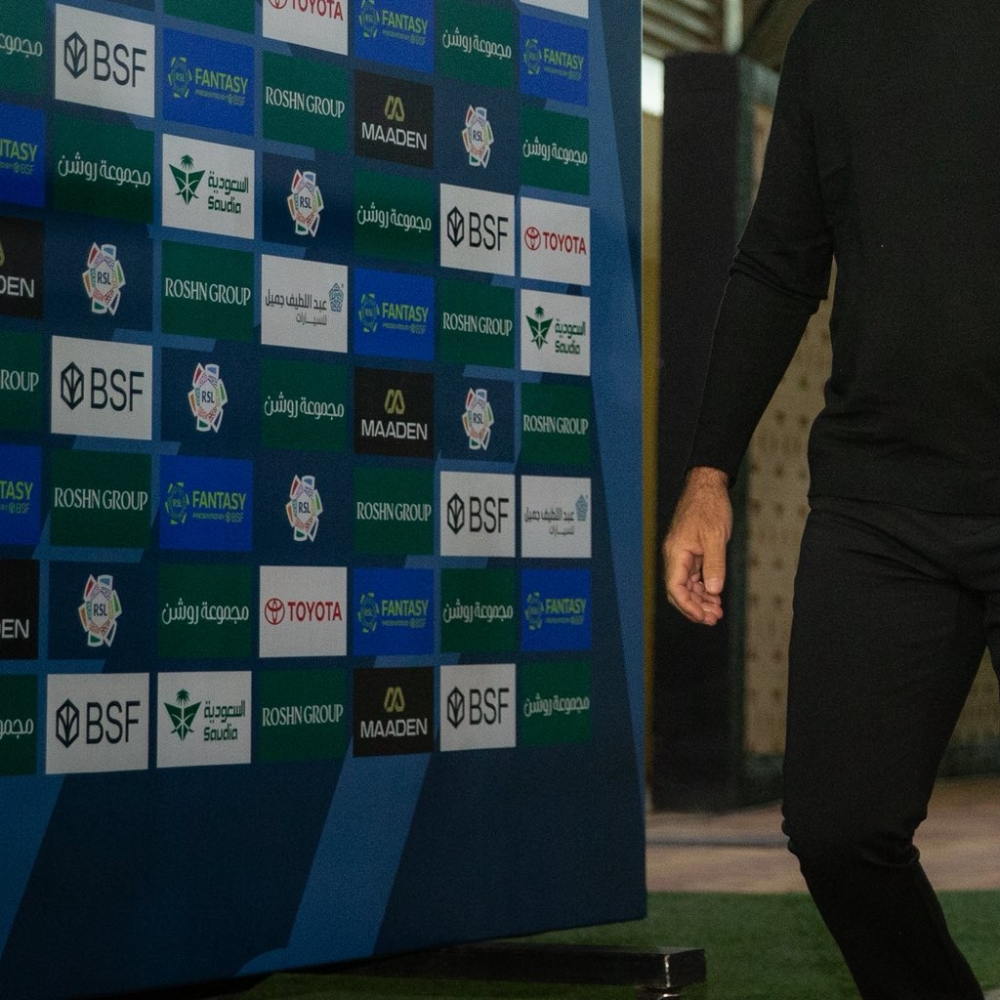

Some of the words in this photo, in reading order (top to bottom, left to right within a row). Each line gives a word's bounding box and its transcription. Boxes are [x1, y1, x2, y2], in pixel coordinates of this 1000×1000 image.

[382, 9, 428, 34] FANTASY
[442, 27, 472, 53] روشن
[473, 35, 511, 59] مجموعة
[94, 39, 146, 87] BSF
[195, 68, 248, 93] FANTASY
[265, 86, 304, 110] ROSHN
[306, 95, 345, 118] GROUP
[362, 122, 427, 149] MAADEN
[473, 130, 483, 142] RSL
[0, 138, 38, 162] TASY
[58, 152, 97, 181] روشن
[99, 160, 151, 187] مجموعة
[208, 172, 249, 197] السعودية
[208, 195, 241, 214] Saudia
[300, 196, 312, 209] RSL
[357, 202, 389, 228] روشن
[390, 208, 431, 232] مجموعة
[469, 211, 508, 250] BSF
[543, 232, 586, 255] TOYOTA
[97, 271, 111, 285] RSL
[165, 277, 207, 300] ROSHN
[209, 283, 251, 305] GROUP
[382, 302, 428, 322] FANTASY
[443, 311, 477, 331] ROSHN
[479, 317, 512, 336] GROUP
[91, 367, 144, 411] BSF
[201, 390, 214, 403] RSL
[264, 392, 298, 418] روشن
[299, 397, 344, 420] مجموعة
[362, 419, 427, 439] MAADEN
[473, 412, 483, 424] RSL
[523, 414, 555, 432] ROSHN
[556, 417, 588, 435] GROUP
[54, 487, 100, 508] ROSHN
[102, 490, 148, 511] GROUP
[192, 490, 246, 510] FANTASY
[298, 501, 310, 513] RSL
[356, 501, 393, 520] ROSHN
[395, 503, 431, 521] GROUP
[469, 496, 509, 533] BSF
[93, 603, 107, 616] RSL
[162, 598, 199, 624] روشن
[200, 601, 249, 624] مجموعة
[288, 601, 342, 622] TOYOTA
[381, 599, 428, 617] FANTASY
[443, 598, 473, 622] روشن
[474, 602, 513, 622] مجموعة
[204, 701, 245, 724] السعودية
[262, 706, 302, 725] ROSHN
[304, 704, 343, 723] GROUP
[469, 688, 509, 725] BSF
[86, 701, 139, 744] BSF
[204, 725, 238, 742] Saudia
[361, 719, 427, 738] MAADEN
